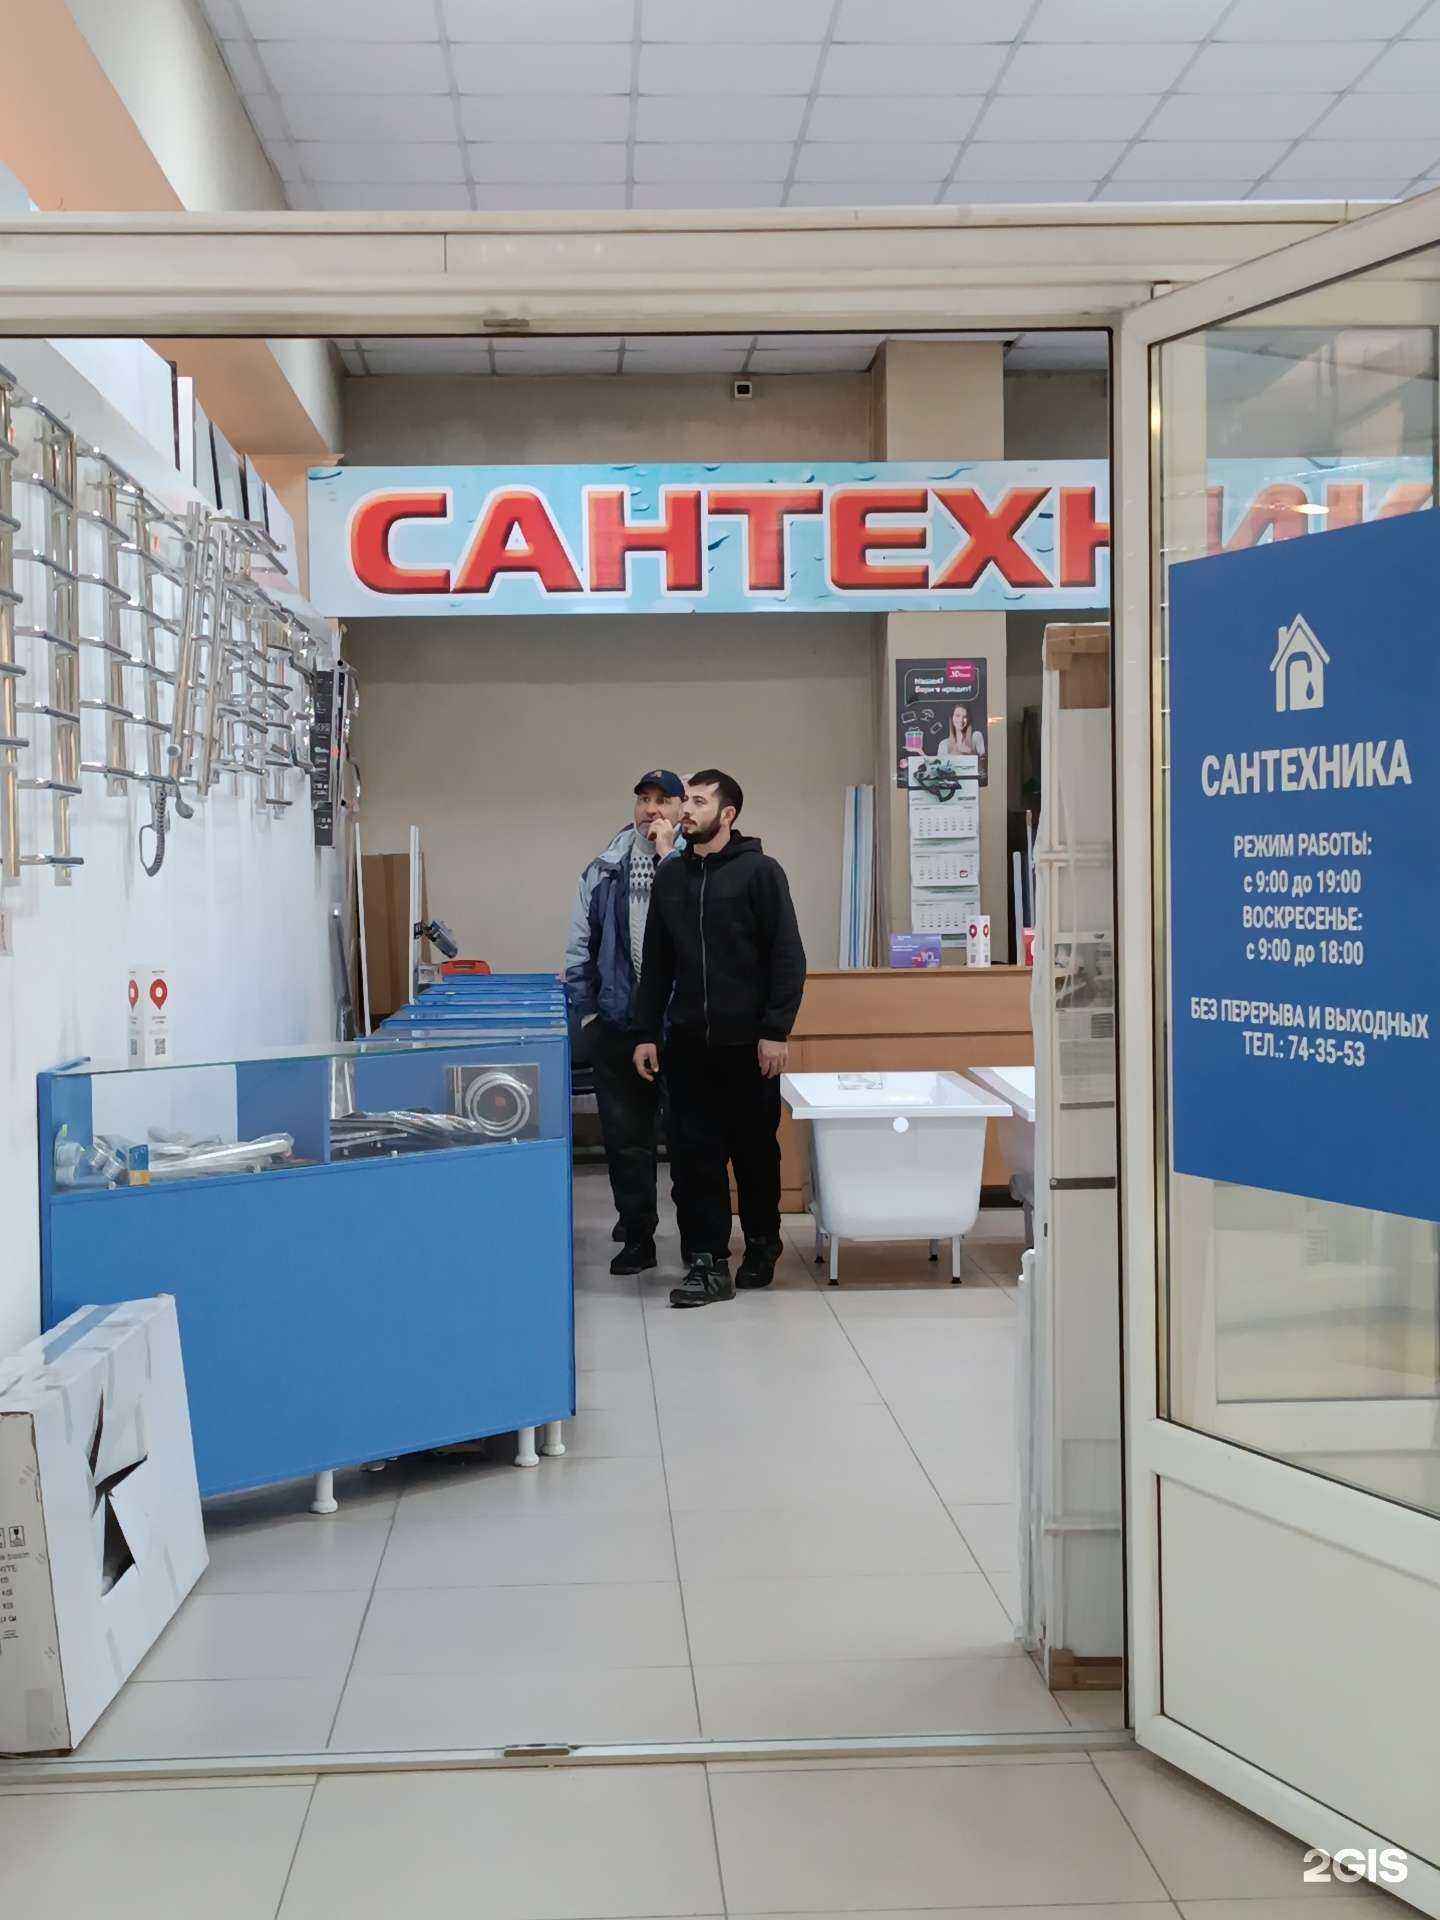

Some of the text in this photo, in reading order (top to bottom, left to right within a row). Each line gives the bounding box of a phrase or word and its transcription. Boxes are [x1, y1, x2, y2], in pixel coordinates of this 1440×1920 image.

[1201, 739, 1412, 797] САНТЕХНИКА
[1233, 831, 1372, 858] РЕЖИМ РАБОТЫ:
[1244, 869, 1361, 897] с 9:00 до 19:00
[1243, 905, 1363, 931] ВОСКРЕСЕНЬЕ:
[1246, 938, 1364, 966] с 9:00 до 18:00
[1191, 997, 1429, 1039] БЕЗ ПЕРЕРЫВА И ВЫХОДНЫХ
[1243, 1031, 1366, 1067] ТЕЛ.: 74-35-53
